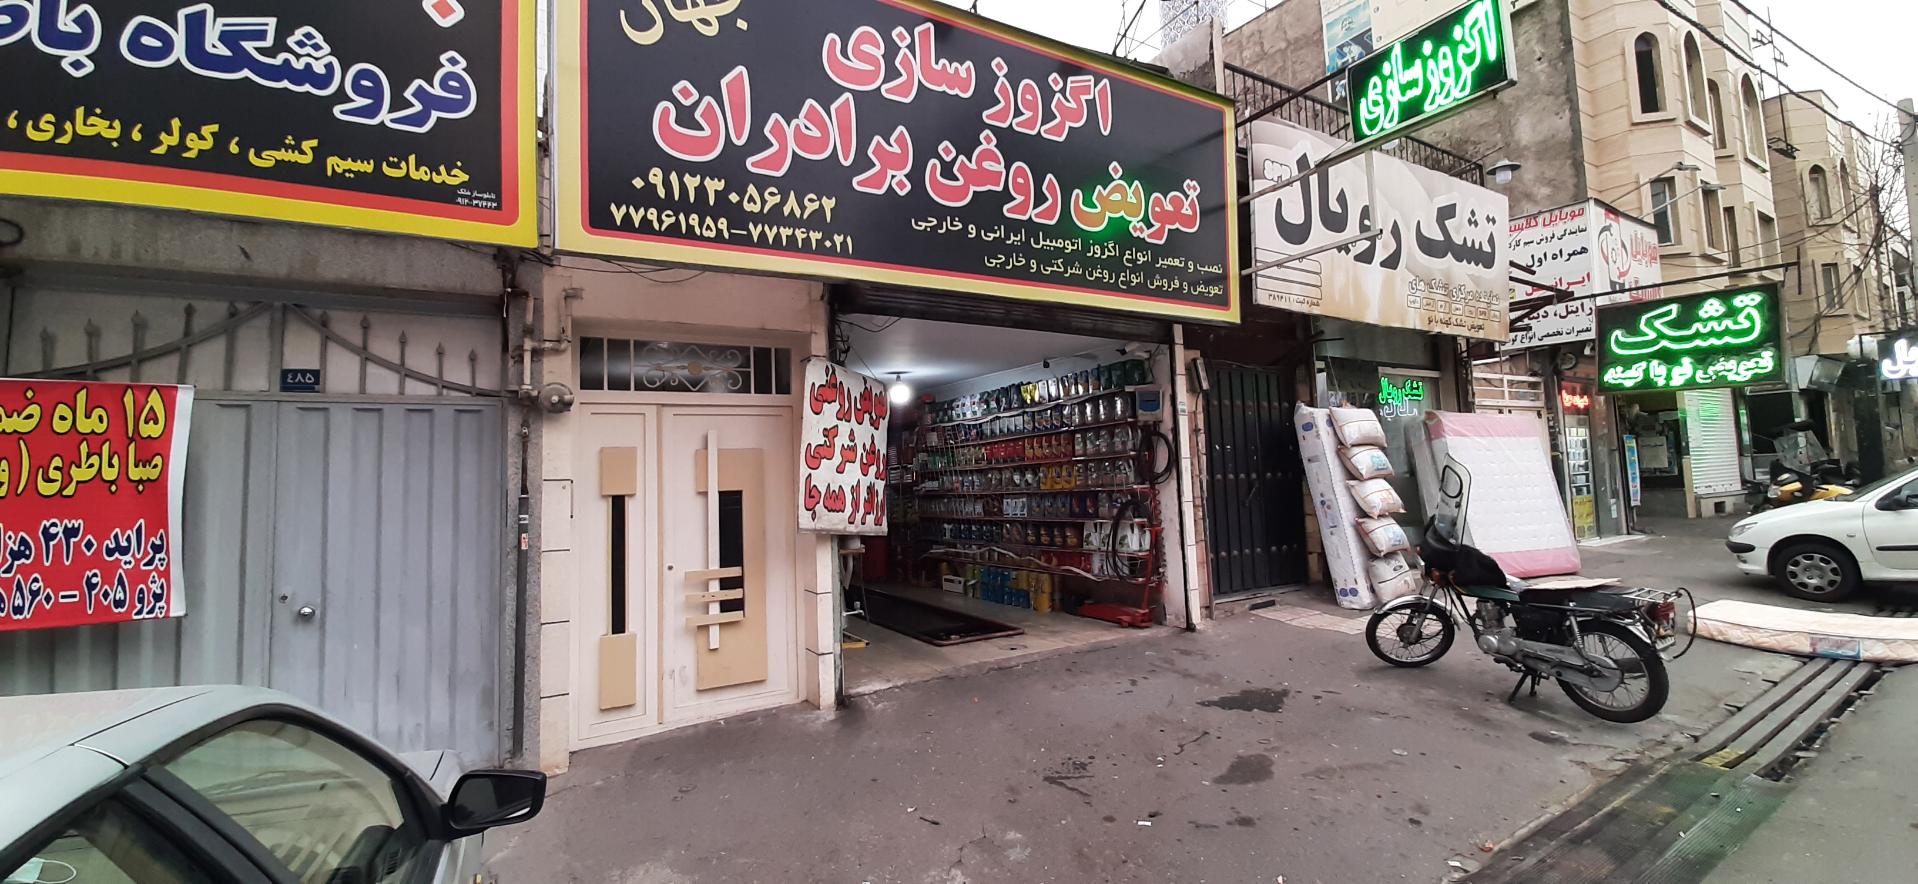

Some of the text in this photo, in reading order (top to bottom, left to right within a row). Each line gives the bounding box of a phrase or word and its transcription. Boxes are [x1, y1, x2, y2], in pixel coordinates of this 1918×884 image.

[120, 4, 477, 133] فروشگاه
[823, 21, 1113, 142] اگزوز سازی
[1360, 0, 1497, 135] اگزوز سازی
[26, 106, 122, 148] بخاری
[151, 117, 219, 158] کولر
[248, 134, 319, 169] کشی
[327, 153, 375, 178] سیم
[382, 155, 470, 186] خدمات
[652, 63, 1201, 244] تعویض روغن برادران
[632, 167, 836, 223] ۰۹۱۲۳۰۵۶۸۶۲
[1274, 151, 1497, 270] تشک رویال
[1543, 207, 1585, 227] موبایل
[911, 215, 1223, 274] نصب و تعمیر انواع اگزوز اتومبیل ایرانی و خارجی
[1523, 239, 1534, 248] سیم
[1536, 230, 1555, 245] فروش
[1557, 225, 1587, 240] نمایندگی
[984, 252, 1224, 297] تعویض و فروش انواع روغن شرکتی و خارجی
[1526, 246, 1589, 268] همراه اول
[1525, 272, 1591, 296] ایرانل
[1520, 332, 1536, 343] انواع
[1538, 329, 1563, 341] تخصصی
[1565, 324, 1592, 336] تعمیرات
[1611, 292, 1762, 355] تشک
[1379, 377, 1424, 405] تشک رویال
[1649, 360, 1666, 387] با
[51, 386, 110, 435] ماه
[122, 386, 167, 440] ۱۵
[854, 376, 888, 430] تعویض
[36, 439, 120, 497] باطری
[127, 441, 164, 494] صبا
[805, 424, 887, 481] روغن شرکتی
[804, 473, 822, 522] جا
[823, 482, 846, 513] همه
[848, 479, 860, 524] از
[39, 518, 97, 566] ۴۳۰
[103, 518, 166, 570] پراید
[10, 574, 54, 619] ۵۶۰
[84, 569, 129, 613] ۴۰۵
[132, 574, 166, 618] پژو
